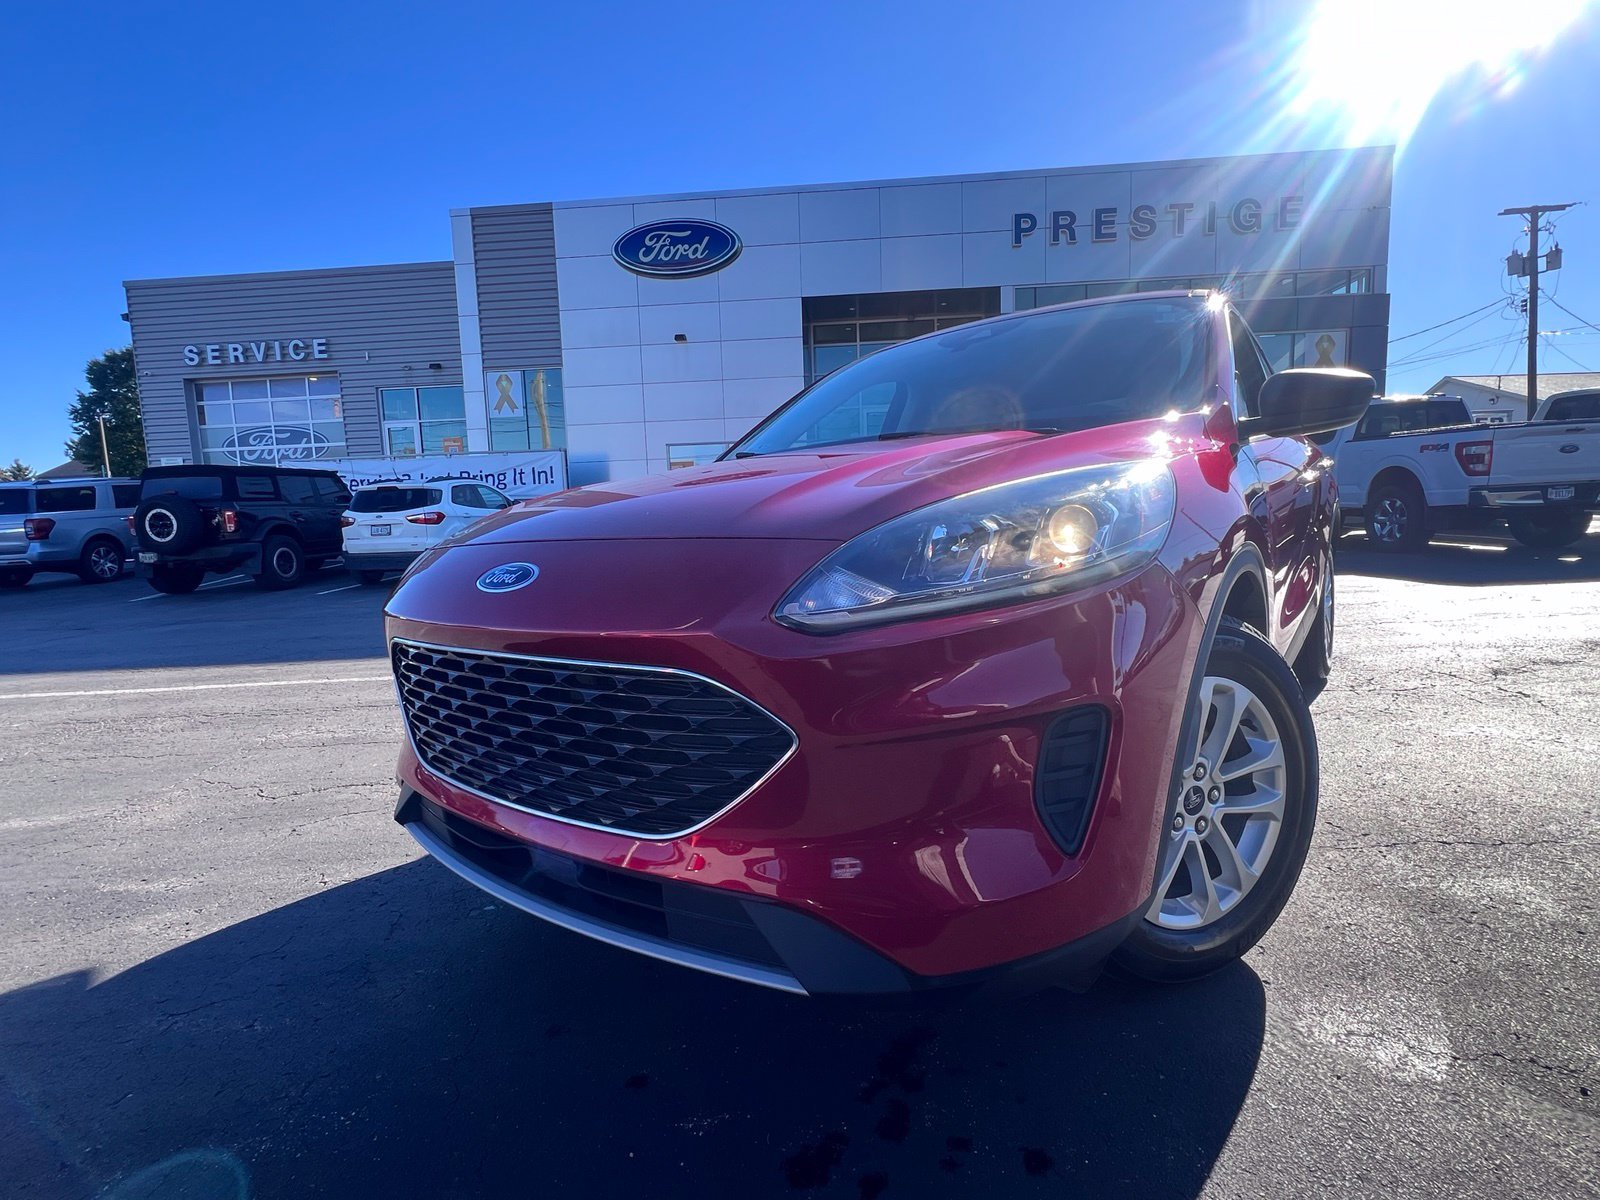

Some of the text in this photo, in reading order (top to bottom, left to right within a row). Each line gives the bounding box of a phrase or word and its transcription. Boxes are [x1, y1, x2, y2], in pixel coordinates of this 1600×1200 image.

[1012, 196, 1303, 248] PRESTIGE
[638, 230, 711, 263] Ford
[183, 338, 329, 366] SERVICE
[243, 431, 308, 461] Ford
[1419, 442, 1450, 454] FX4
[512, 467, 526, 486] It
[531, 465, 555, 485] In!
[486, 566, 524, 584] Ford
